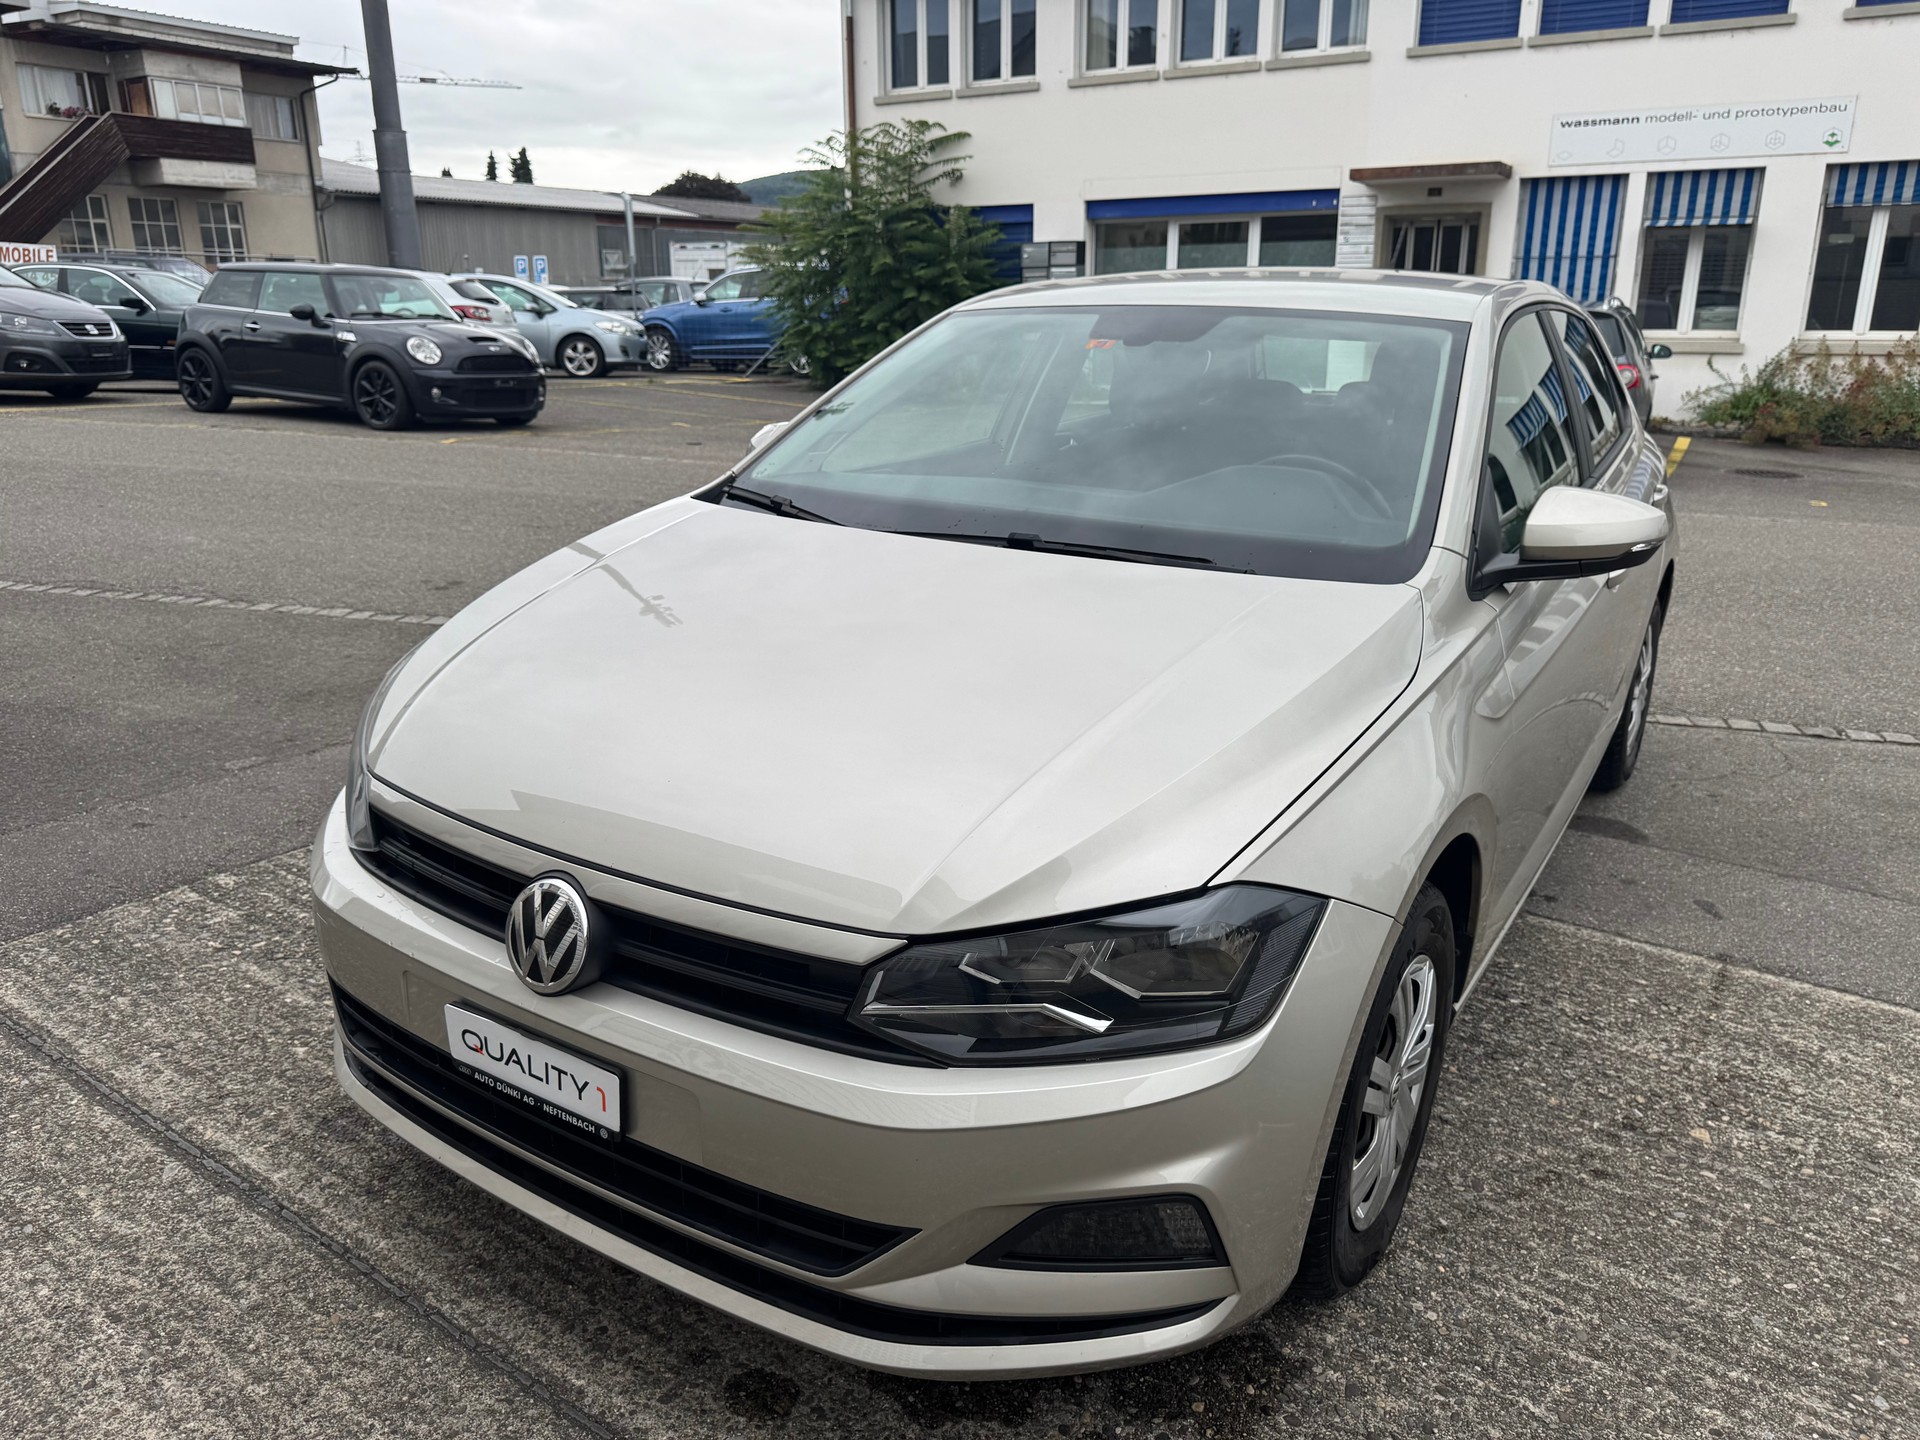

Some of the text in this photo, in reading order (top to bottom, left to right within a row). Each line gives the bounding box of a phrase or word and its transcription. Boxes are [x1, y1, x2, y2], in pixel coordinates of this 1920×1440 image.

[1560, 103, 1848, 129] wassmann modell- und prototypenbau
[461, 1028, 590, 1101] QUALITY
[474, 1071, 596, 1134] AUTO DÜNKI AG NEFTENBACH
